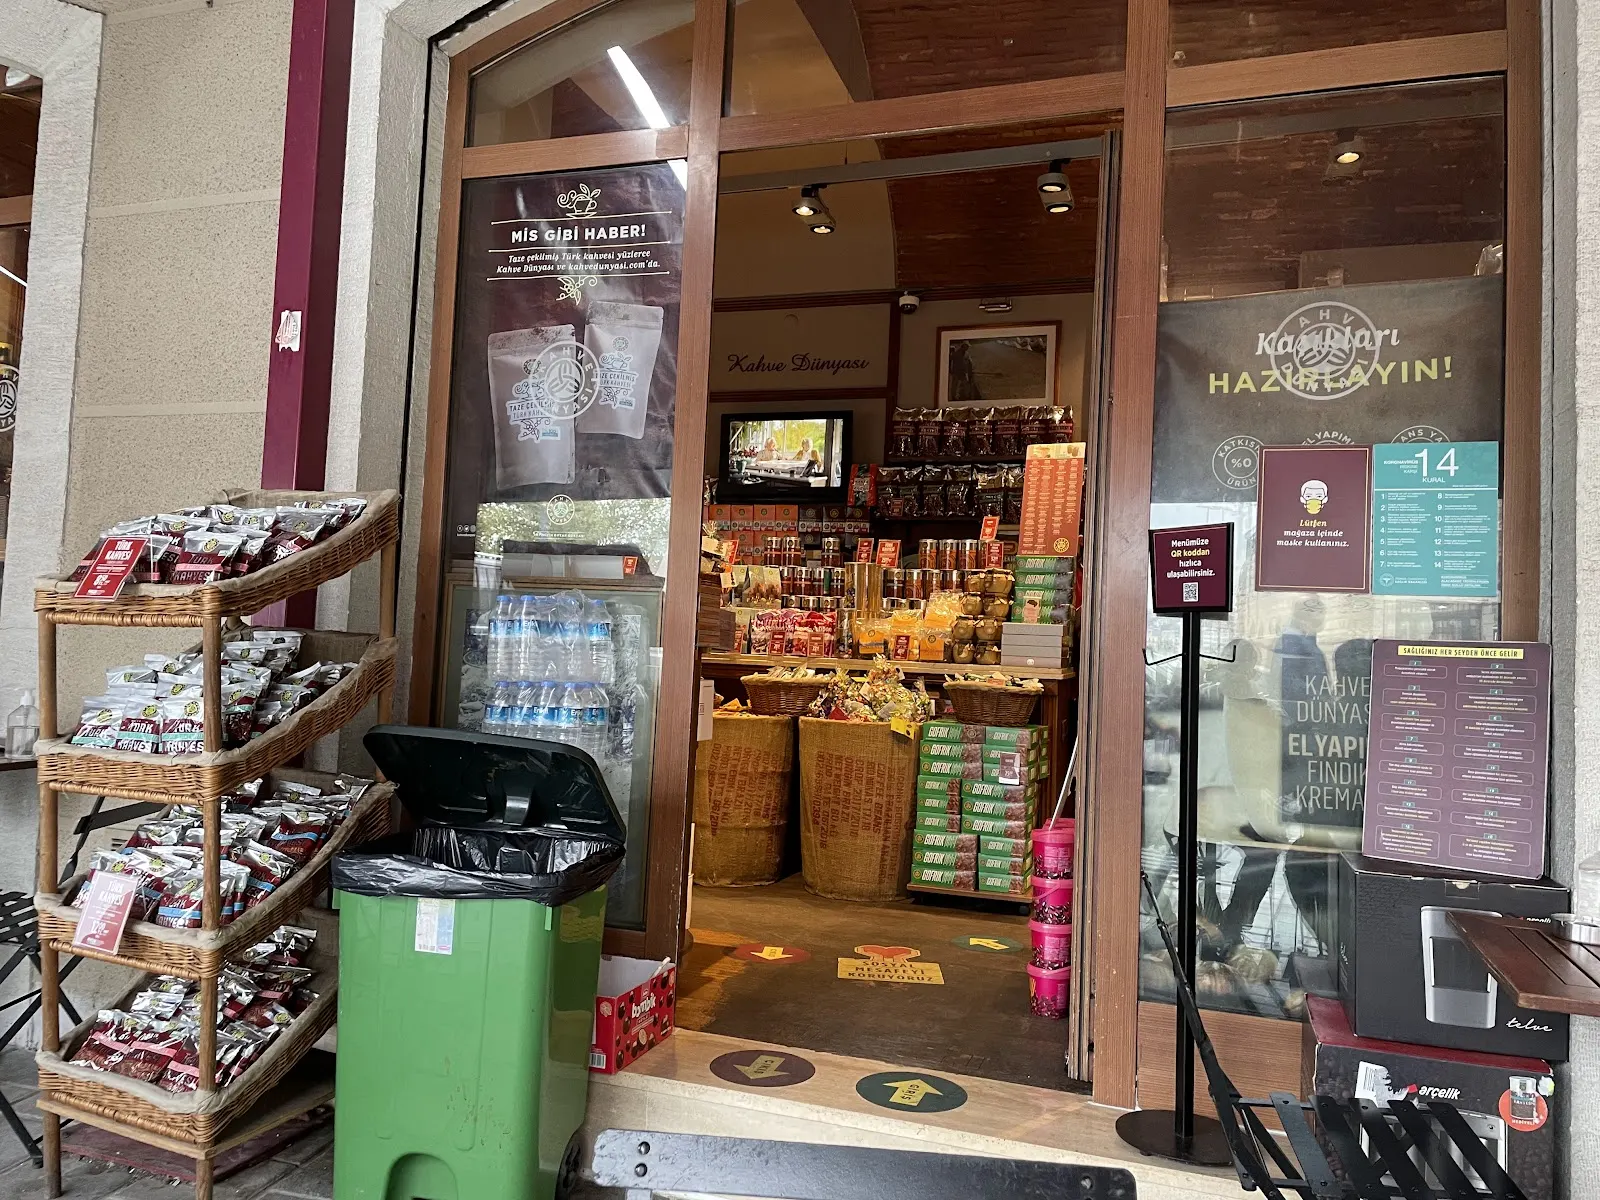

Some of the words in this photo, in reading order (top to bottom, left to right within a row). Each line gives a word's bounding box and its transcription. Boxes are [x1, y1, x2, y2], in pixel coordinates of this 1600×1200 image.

[511, 230, 539, 243] MİS
[544, 226, 579, 241] GİBİ
[584, 224, 646, 240] HABER!
[508, 255, 525, 263] Taze
[526, 252, 560, 263] çekilmiş
[562, 251, 581, 261] Türk
[583, 250, 615, 260] kahvesi
[617, 250, 650, 261] yüzlerce
[496, 265, 521, 274] Kahve
[523, 262, 554, 274] Dünyası
[727, 354, 787, 372] Kahve
[791, 353, 870, 375] Dünyası
[1415, 447, 1459, 477] 14
[1227, 476, 1257, 487] ÜRÜN
[1300, 519, 1327, 528] Lütfen
[1283, 530, 1315, 538] mağaza
[1317, 530, 1344, 538] içinde
[1171, 538, 1209, 547] Menümüze
[1183, 548, 1210, 557] koddan
[1179, 559, 1202, 567] hızlıca
[1166, 569, 1216, 579] ulaşabilirsiniz.
[1403, 647, 1438, 655] SAĞLIĞINIZ
[1454, 649, 1479, 657] ŞEYDEN
[1480, 647, 1497, 657] ÖNCE
[1499, 649, 1518, 657] GELİR
[1305, 675, 1370, 697] KAHVE
[1288, 733, 1313, 756] EL
[1314, 734, 1368, 759] YAPI
[855, 966, 925, 975] MESAFEYİ
[848, 972, 934, 982] KORUYORUZ
[1506, 1017, 1552, 1032] telve
[901, 1084, 920, 1100] GİRİŞ
[1419, 1083, 1461, 1100] arçelik
